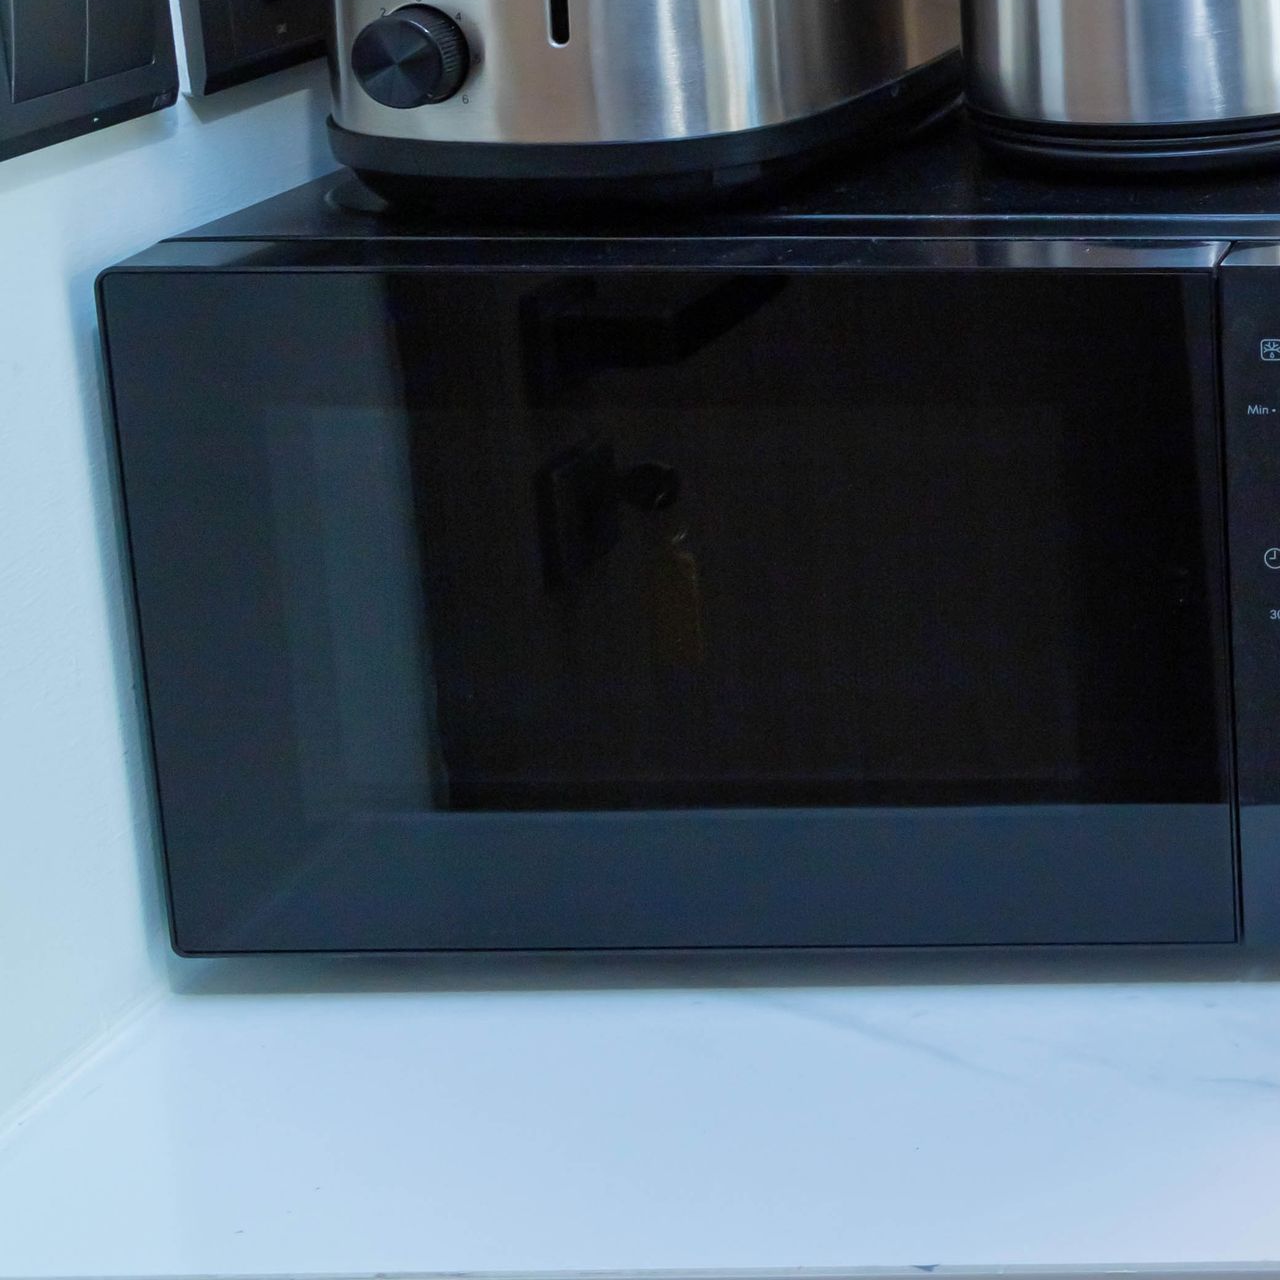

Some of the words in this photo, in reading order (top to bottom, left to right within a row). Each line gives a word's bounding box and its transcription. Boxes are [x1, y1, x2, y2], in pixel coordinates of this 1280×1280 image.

[455, 12, 462, 21] 4
[462, 94, 469, 104] 6
[1247, 405, 1269, 415] Min
